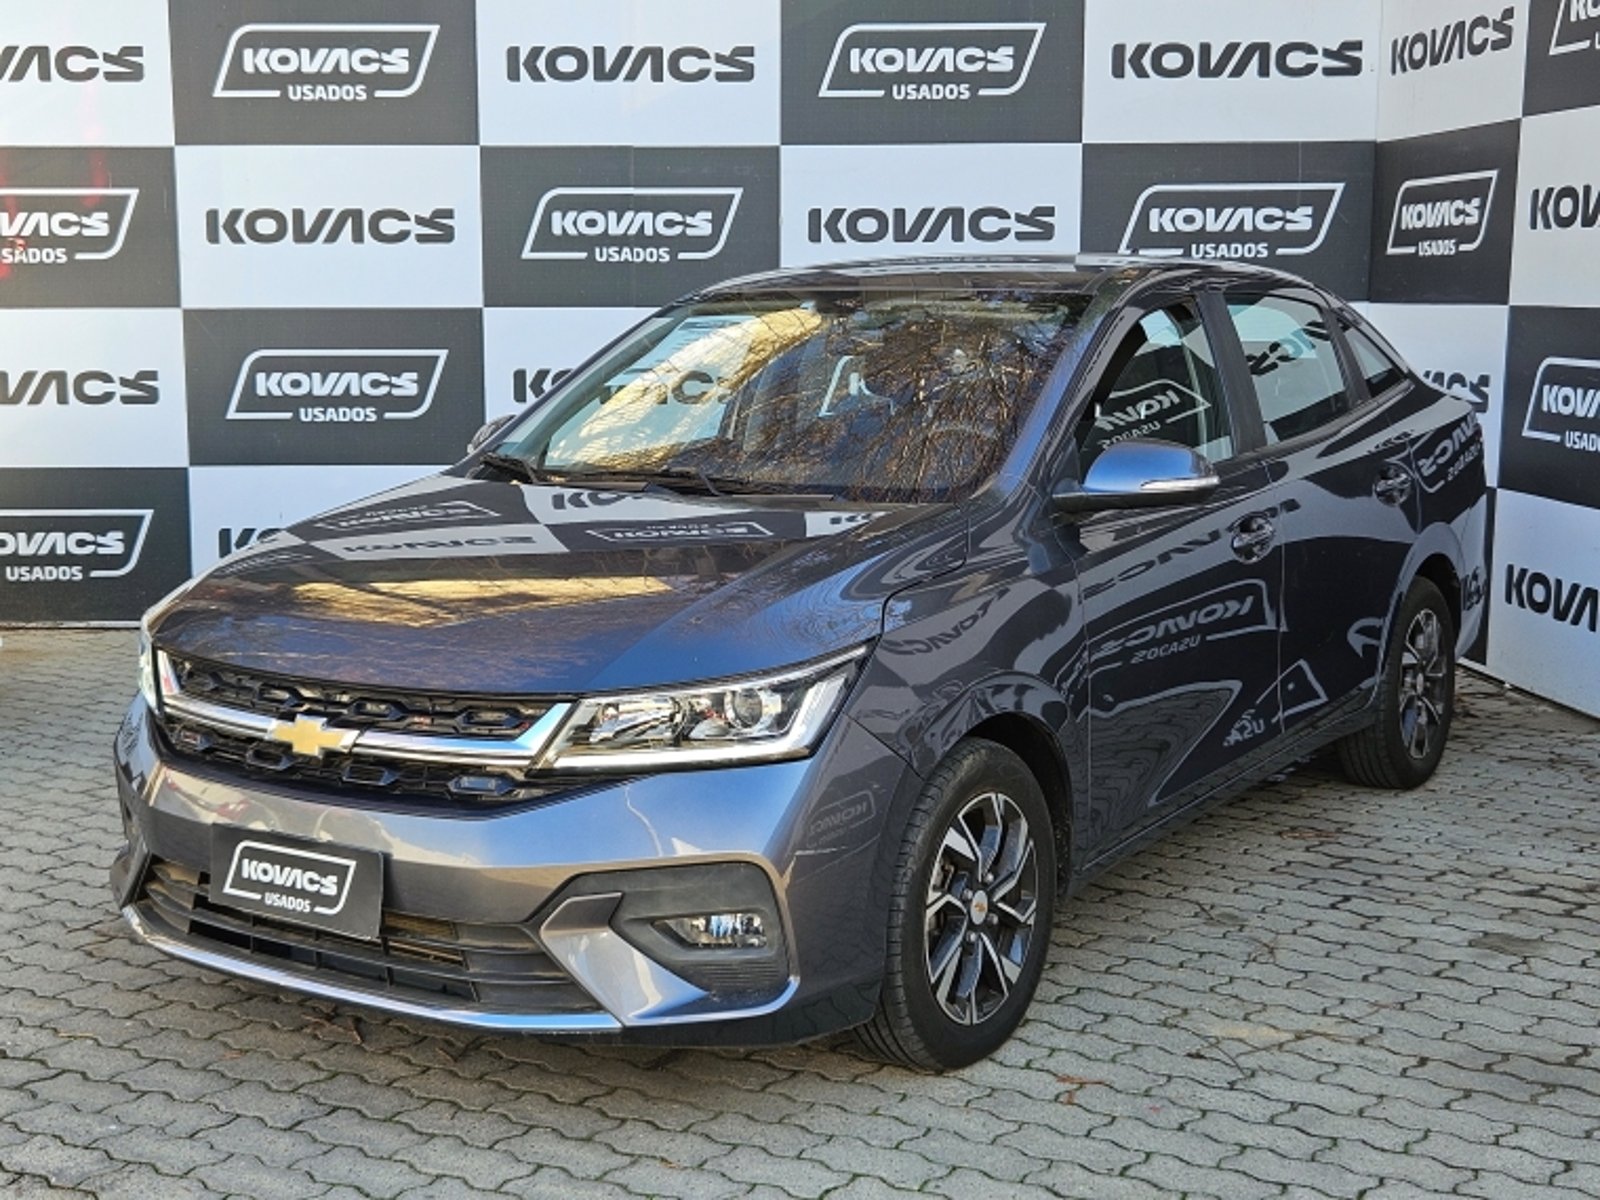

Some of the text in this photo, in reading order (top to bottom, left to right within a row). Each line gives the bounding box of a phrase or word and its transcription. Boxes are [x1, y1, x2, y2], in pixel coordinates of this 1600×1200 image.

[1391, 6, 1515, 75] KOVACS
[242, 47, 410, 75] KOVACS
[506, 45, 755, 83] KOVACS
[849, 46, 1015, 74] KOVACS
[1110, 40, 1363, 79] KOVACS
[287, 84, 368, 101] USADOS
[891, 83, 971, 100] USADOS
[205, 208, 456, 245] KOVACS
[551, 210, 713, 236] KOVACS
[807, 206, 1057, 243] KOVACS
[1148, 206, 1314, 233] KOVACS
[1401, 197, 1482, 231] KOVACS
[593, 246, 671, 263] USADOS
[1190, 243, 1269, 259] USADOS
[1418, 239, 1457, 257] USADOS
[255, 371, 419, 398] KOVACS
[299, 407, 378, 422] USADOS
[1565, 430, 1600, 452] USAD
[5, 565, 84, 581] USADOS
[241, 858, 338, 896] KOVACS
[264, 891, 311, 914] USADOS
